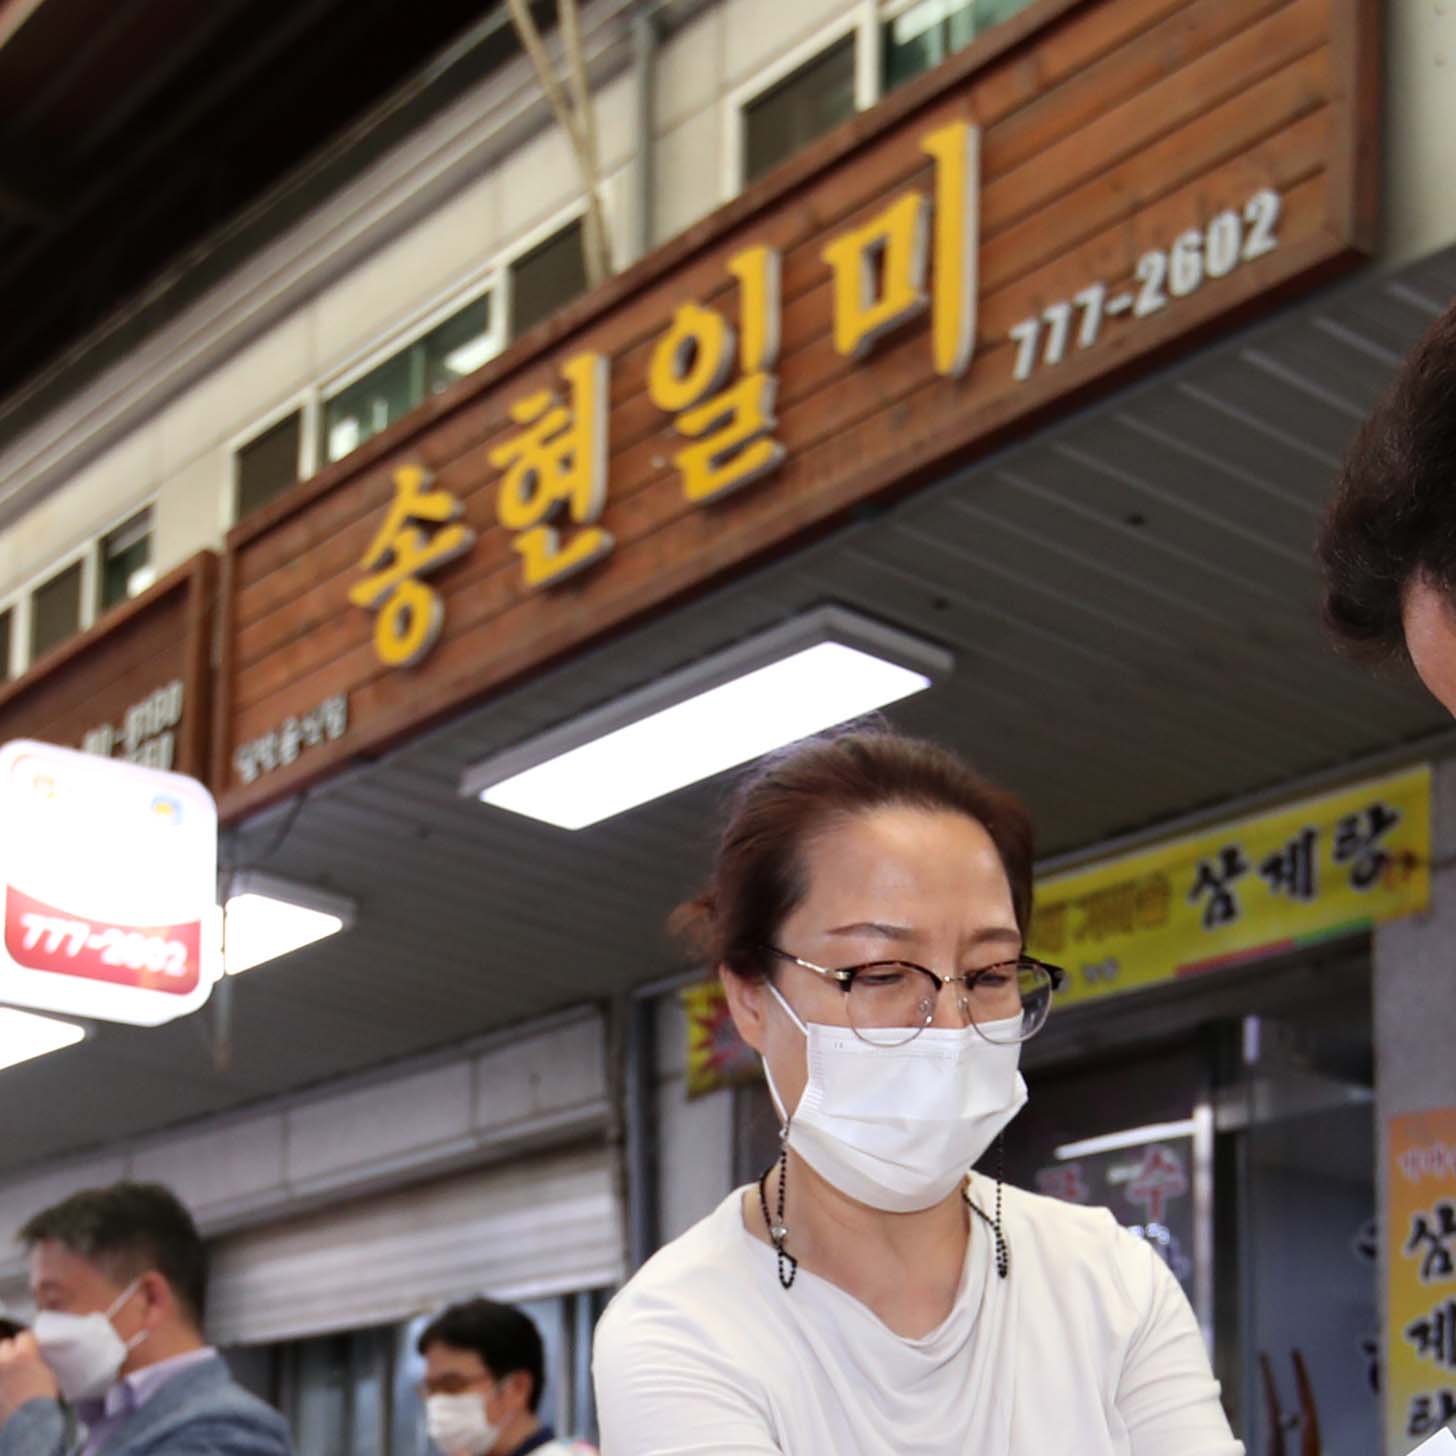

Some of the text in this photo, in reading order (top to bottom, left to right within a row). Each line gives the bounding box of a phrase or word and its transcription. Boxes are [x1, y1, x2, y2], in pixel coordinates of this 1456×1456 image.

[1008, 188, 1282, 382] 777-2602
[348, 119, 982, 670] 송현일미
[1188, 802, 1402, 932] 삼계탕
